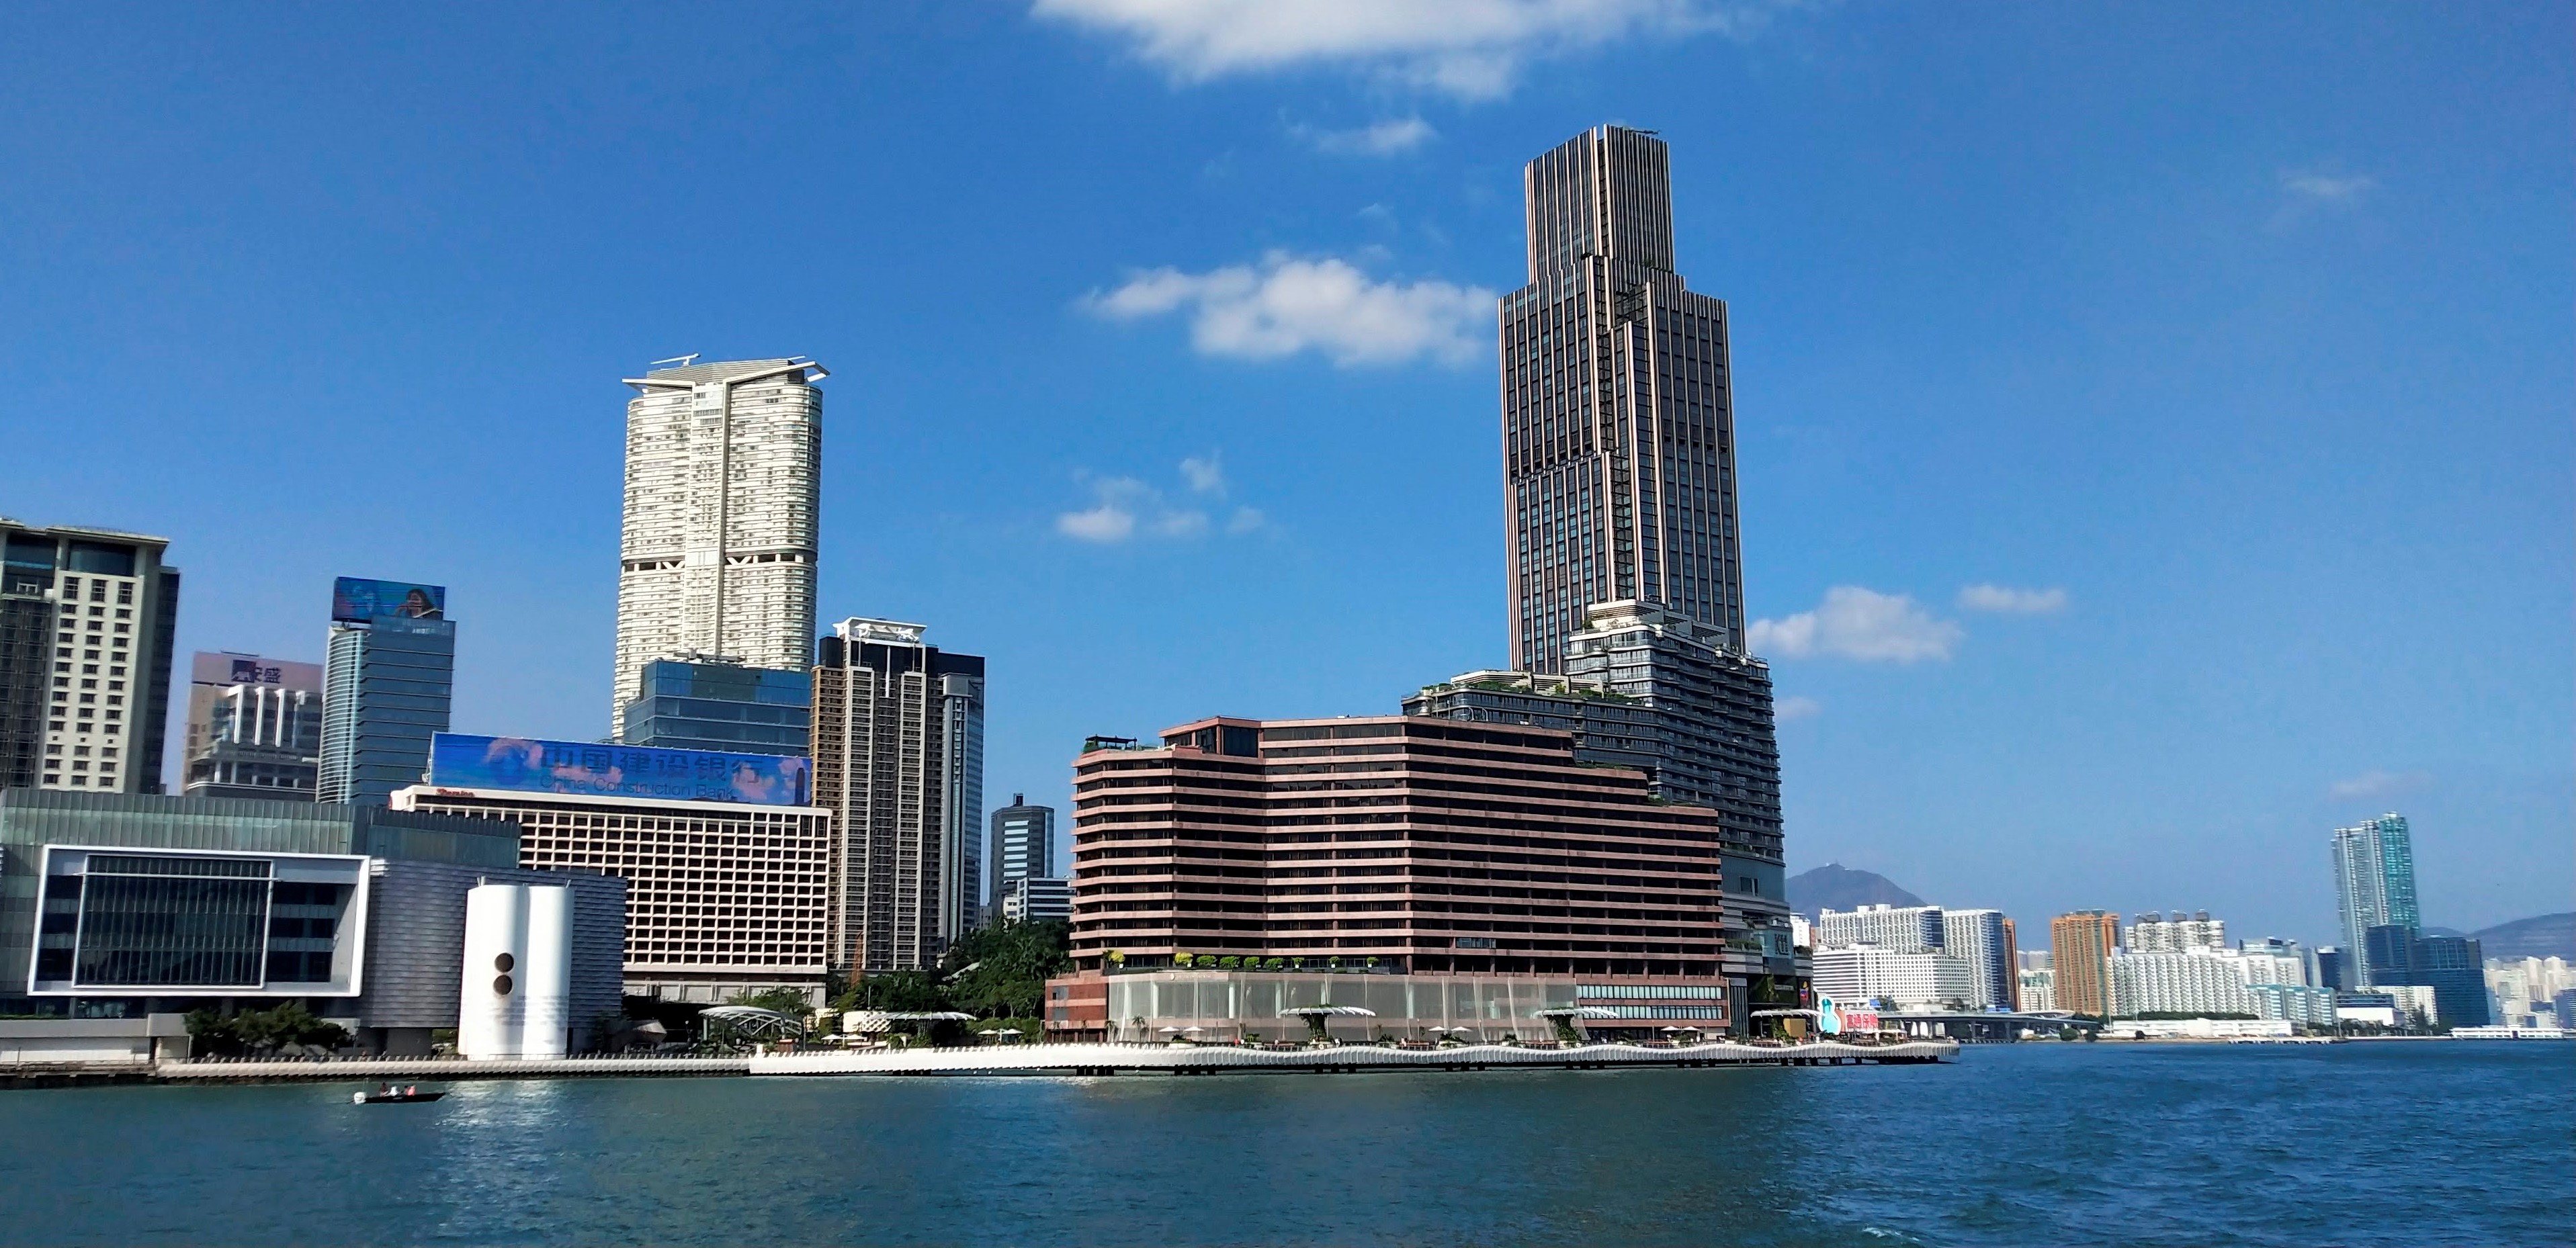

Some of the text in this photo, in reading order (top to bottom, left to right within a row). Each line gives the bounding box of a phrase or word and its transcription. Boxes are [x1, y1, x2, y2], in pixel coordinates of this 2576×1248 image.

[541, 746, 763, 784] 中国建设银行
[540, 774, 735, 799] China Construction Bank
[1774, 933, 1789, 955] K11
